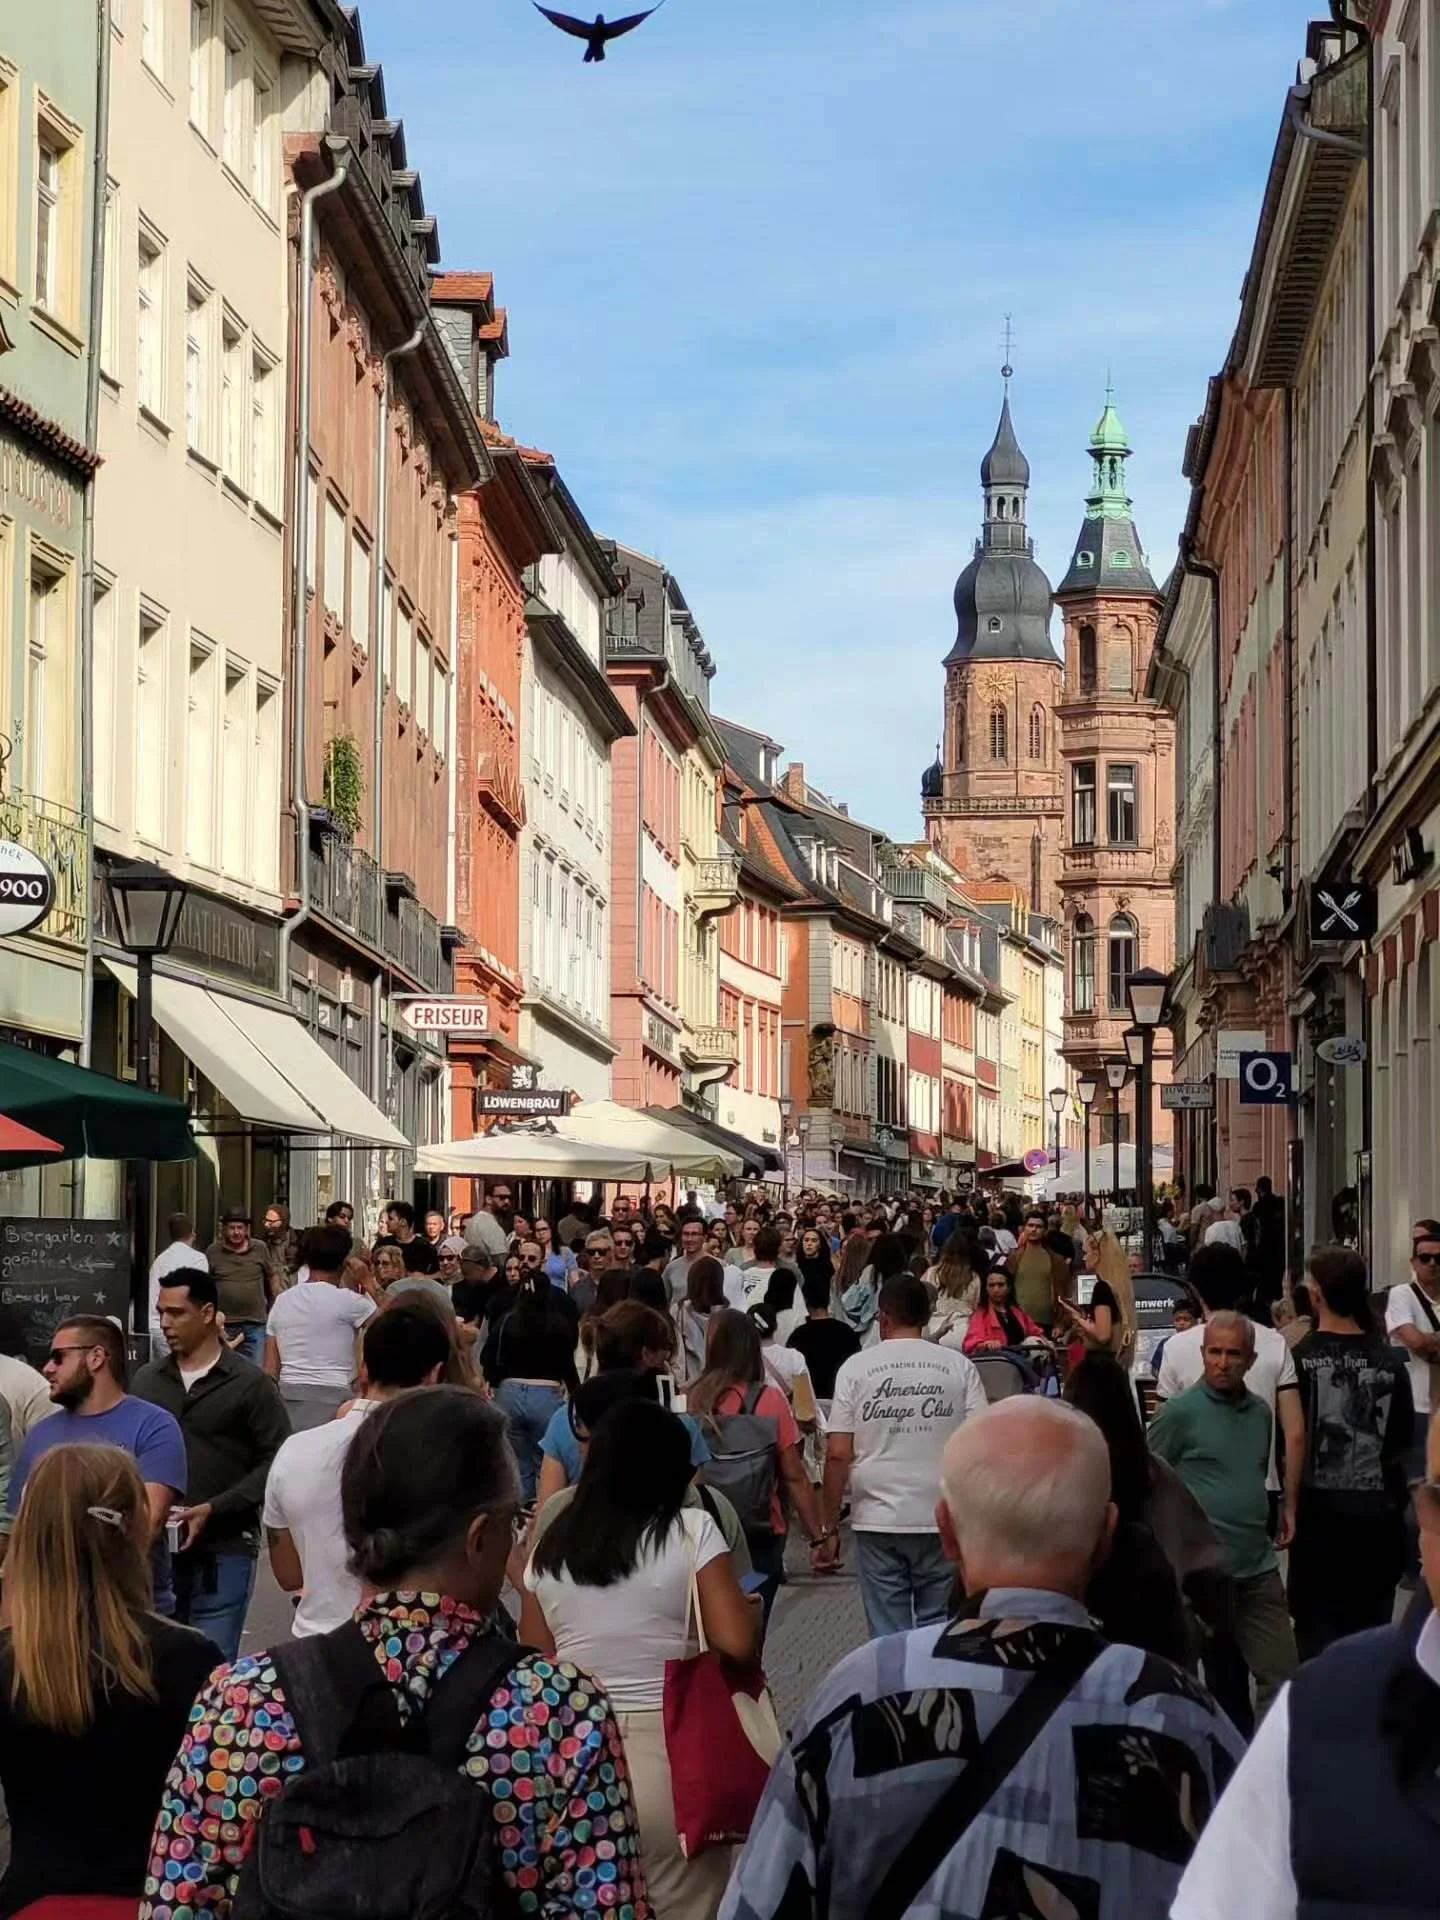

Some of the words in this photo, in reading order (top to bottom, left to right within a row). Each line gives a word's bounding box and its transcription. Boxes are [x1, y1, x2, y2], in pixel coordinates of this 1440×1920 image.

[414, 1007, 483, 1025] FRISEUR
[5, 1224, 96, 1248] Biergarten
[1135, 1297, 1175, 1308] enwerk
[872, 1377, 945, 1399] American
[862, 1400, 915, 1422] Vintage
[921, 1397, 954, 1419] Club
